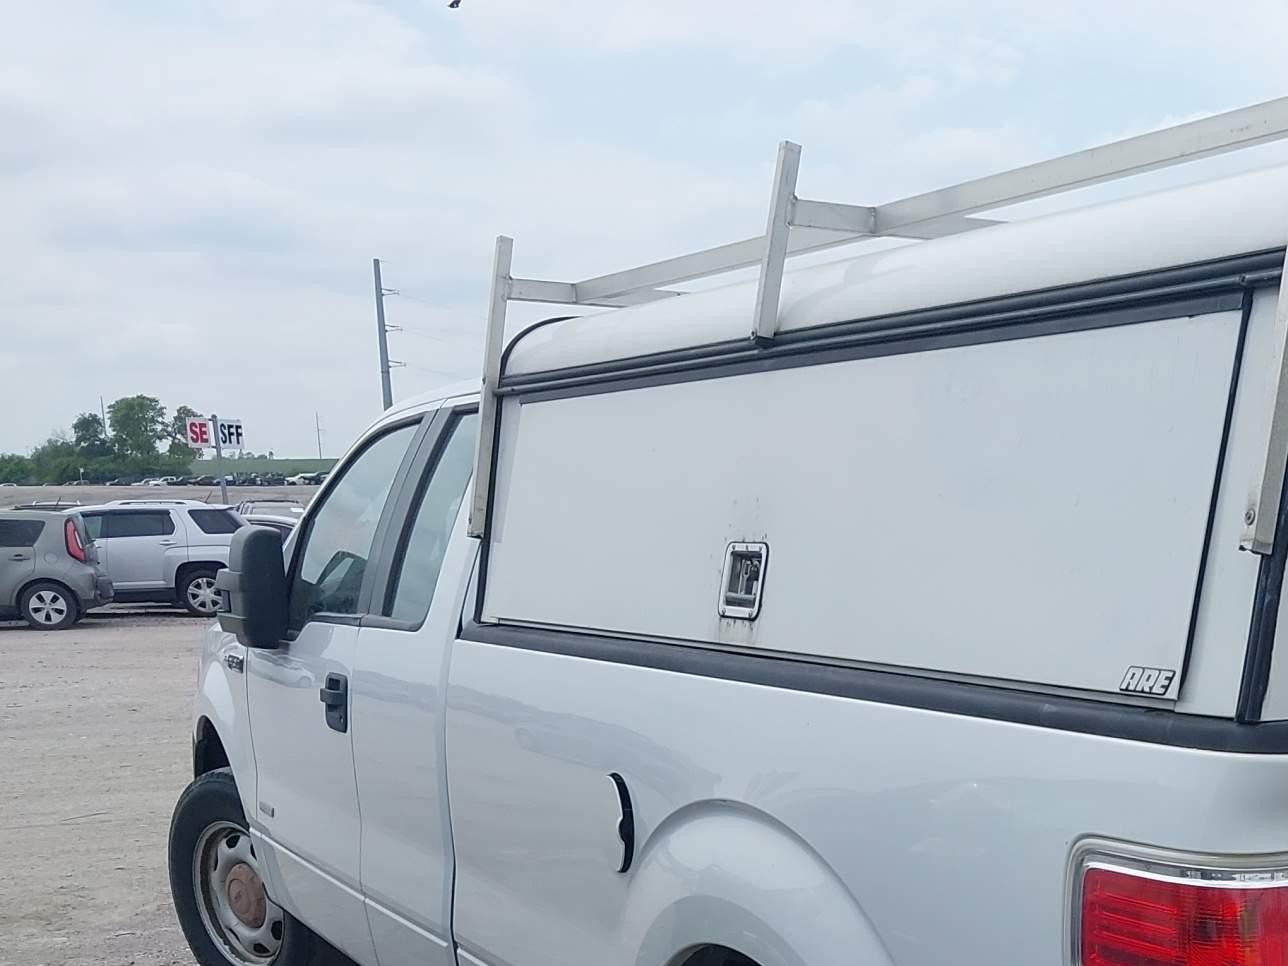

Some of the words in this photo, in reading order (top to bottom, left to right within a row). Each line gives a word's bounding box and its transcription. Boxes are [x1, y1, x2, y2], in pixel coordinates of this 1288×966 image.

[189, 422, 209, 444] SE
[219, 423, 243, 445] SFF
[1119, 665, 1177, 696] ARE
